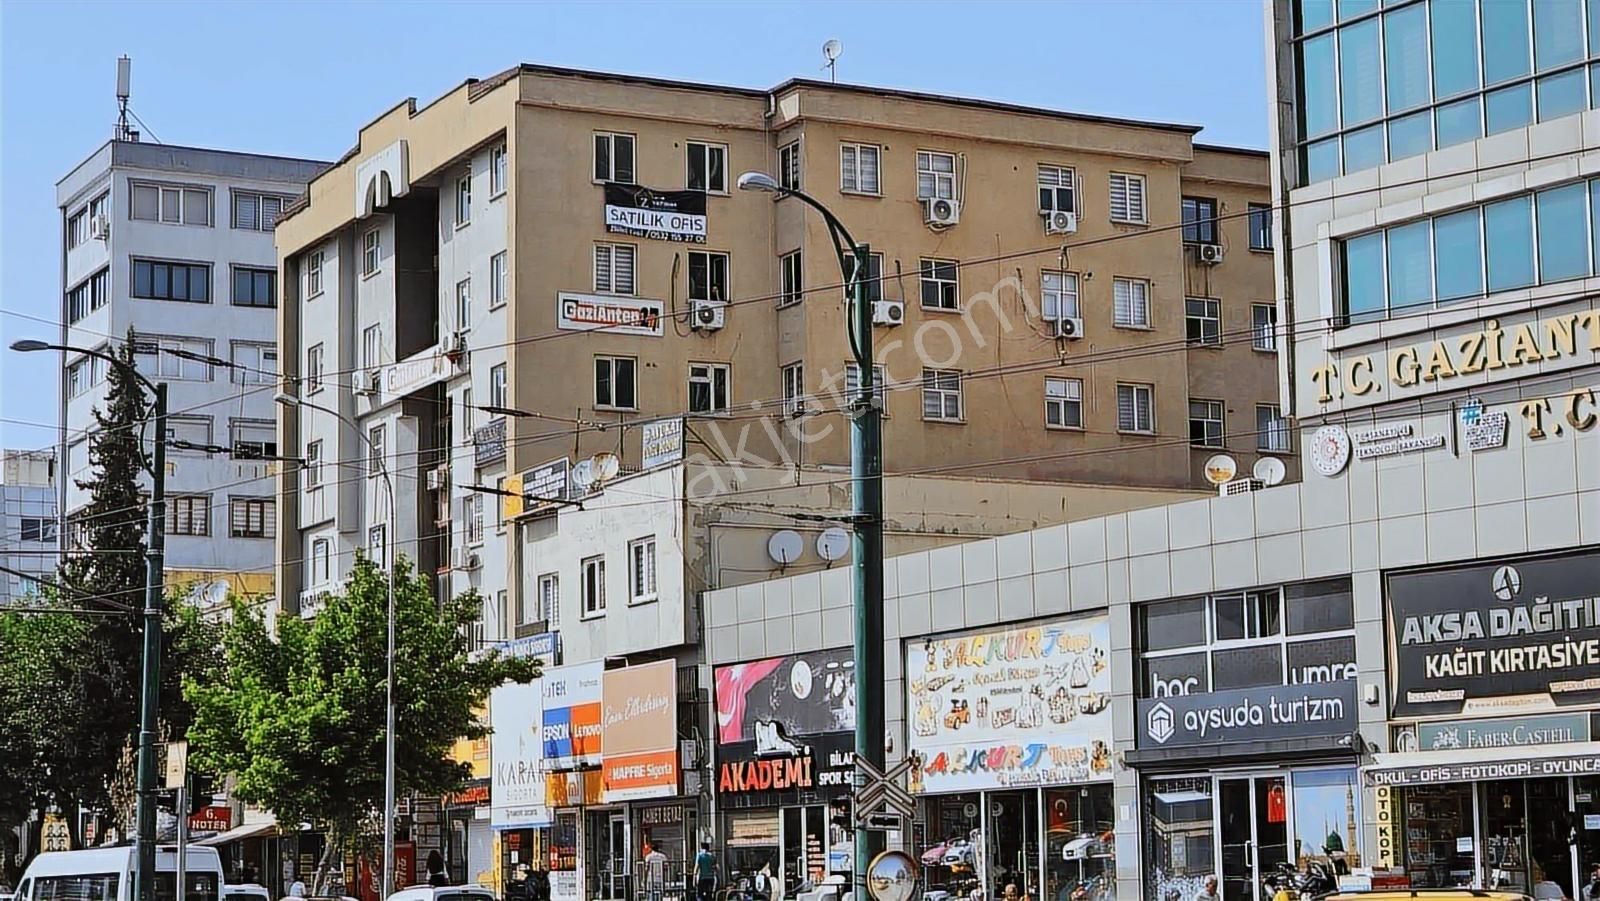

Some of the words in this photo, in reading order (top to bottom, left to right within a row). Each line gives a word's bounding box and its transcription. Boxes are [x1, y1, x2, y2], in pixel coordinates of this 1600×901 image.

[610, 208, 665, 228] SATILIK
[670, 216, 704, 231] OFİS
[1312, 356, 1382, 404] T.C.
[1401, 611, 1485, 645] AKSA
[1425, 647, 1486, 678] KAĞIT
[1490, 636, 1600, 673] KIRTASİYE
[1184, 697, 1264, 737] aysuda
[1269, 695, 1344, 724] turizm
[543, 724, 569, 742] EPSON
[575, 723, 602, 738] Lenovo
[498, 759, 545, 786] KARAR
[612, 765, 645, 780] MAPFRE
[646, 763, 672, 779] Sigorta
[818, 771, 842, 786] SPOR
[1375, 772, 1410, 785] OKUL
[1420, 767, 1450, 781] OFİS
[1461, 762, 1531, 779] FOTOKOPİ
[192, 820, 227, 830] NOTER
[206, 808, 218, 820] 6.
